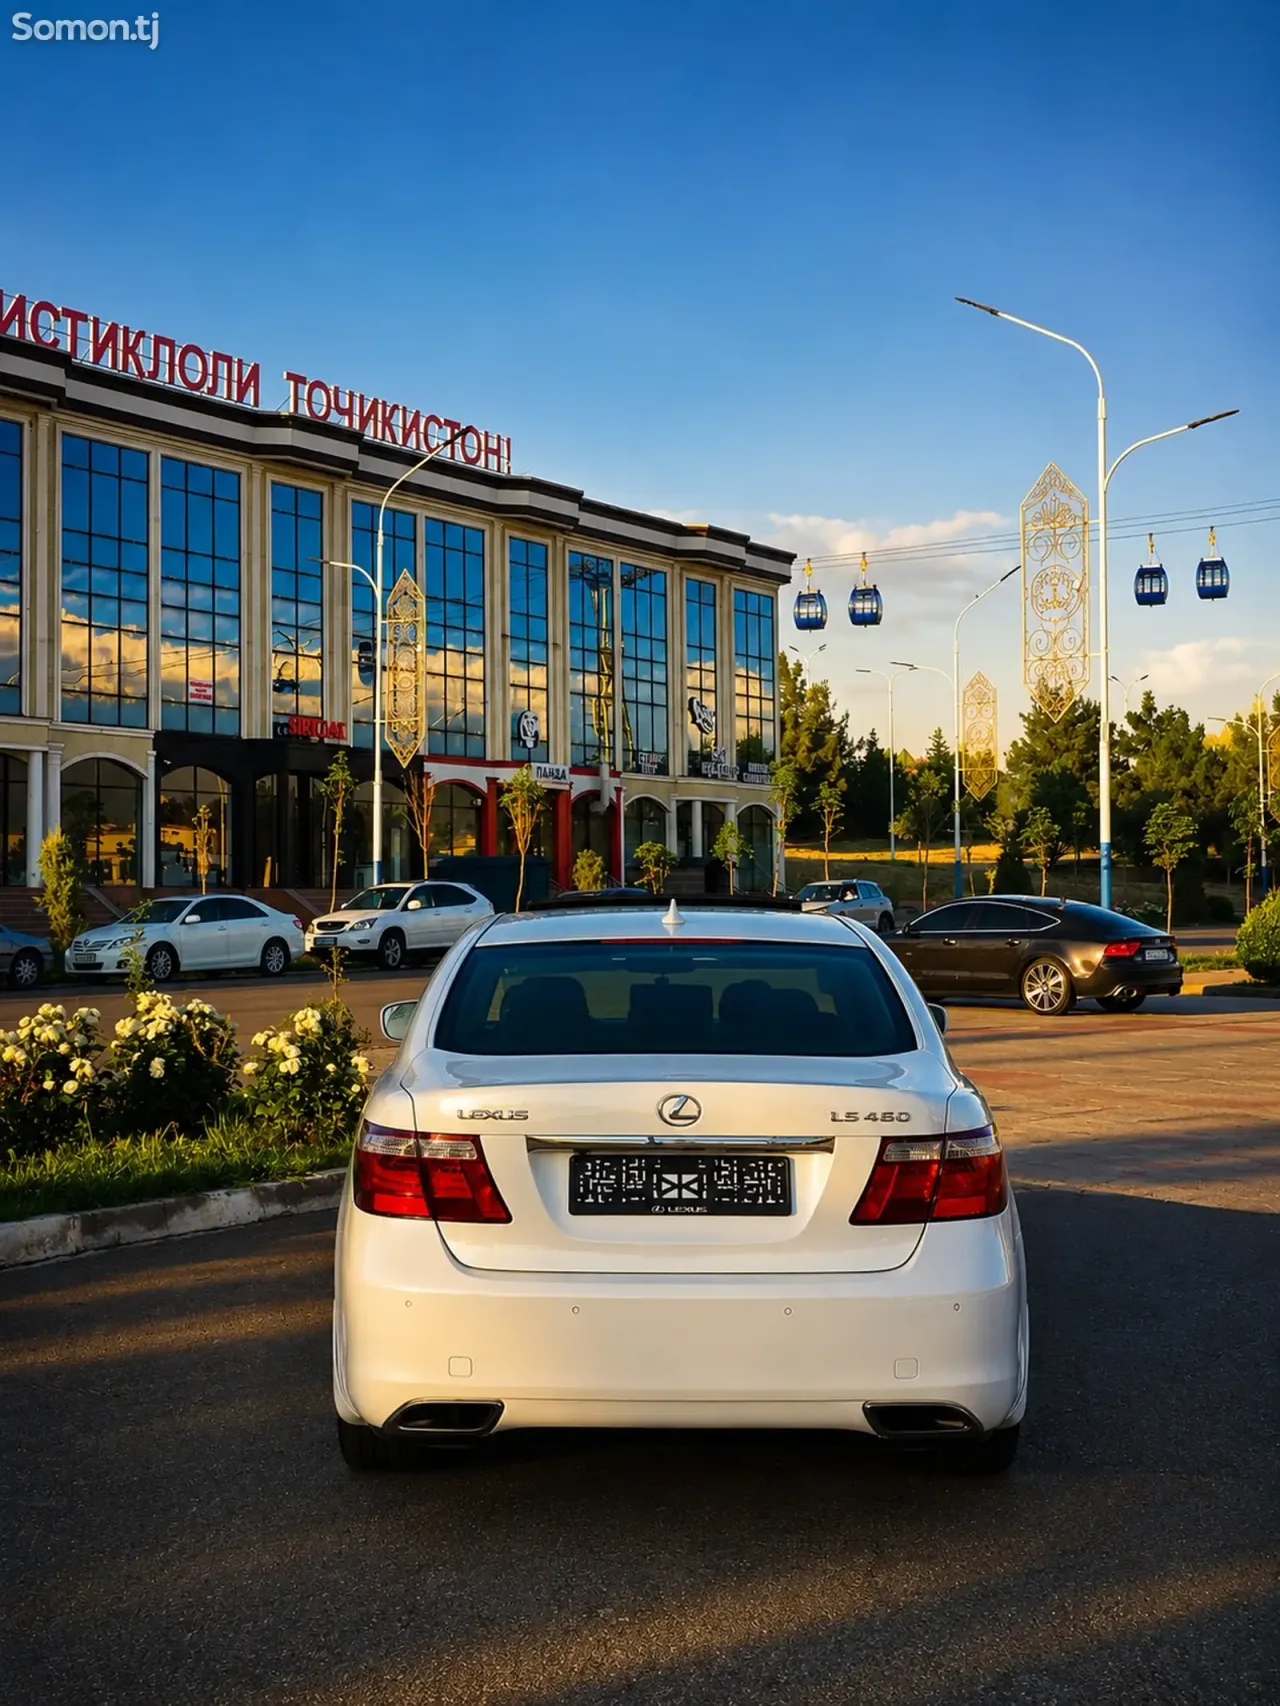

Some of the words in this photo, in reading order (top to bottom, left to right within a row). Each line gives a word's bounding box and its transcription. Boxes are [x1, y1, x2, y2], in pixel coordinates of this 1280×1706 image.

[457, 1109, 529, 1120] LEXUS
[830, 1111, 859, 1122] LS
[863, 1111, 911, 1122] 460
